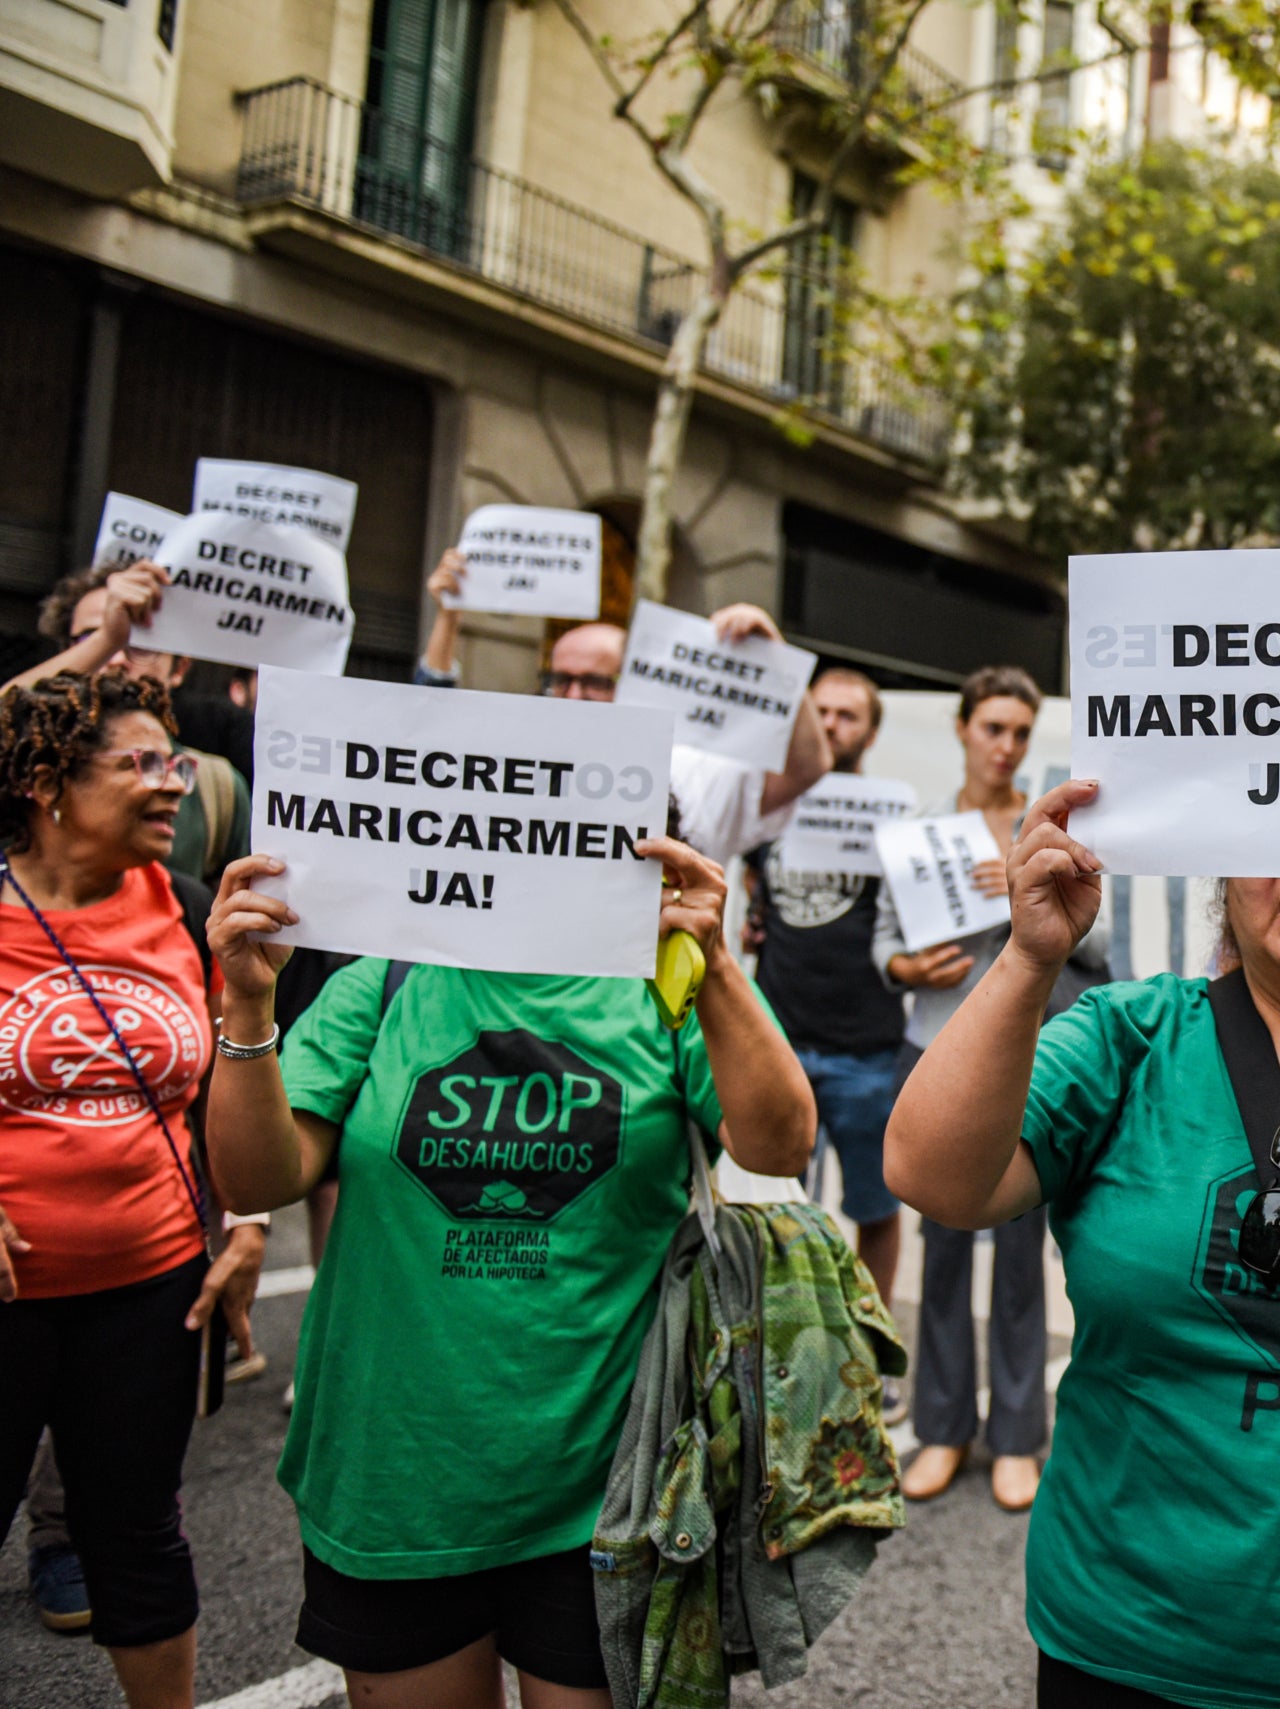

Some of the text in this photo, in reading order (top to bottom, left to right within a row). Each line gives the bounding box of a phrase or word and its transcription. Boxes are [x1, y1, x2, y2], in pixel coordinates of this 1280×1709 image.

[236, 482, 323, 509] DECRET
[198, 540, 314, 585] DECRET
[217, 608, 264, 637] JA!
[672, 642, 767, 683] DECRET
[629, 657, 791, 719] MARICARMEN
[686, 705, 728, 730] JA!
[345, 742, 574, 797] DECRET
[266, 790, 648, 861] MARICARMEN
[407, 869, 495, 910] JA!
[89, 975, 198, 1062] LLOGATERES
[428, 1072, 601, 1133] STOP
[418, 1137, 593, 1173] DESAHUCIOS
[443, 1248, 548, 1265] DE AFECTADOS
[445, 1229, 550, 1247] PLATAFORMA
[442, 1265, 546, 1280] POR LA HIPOTECA
